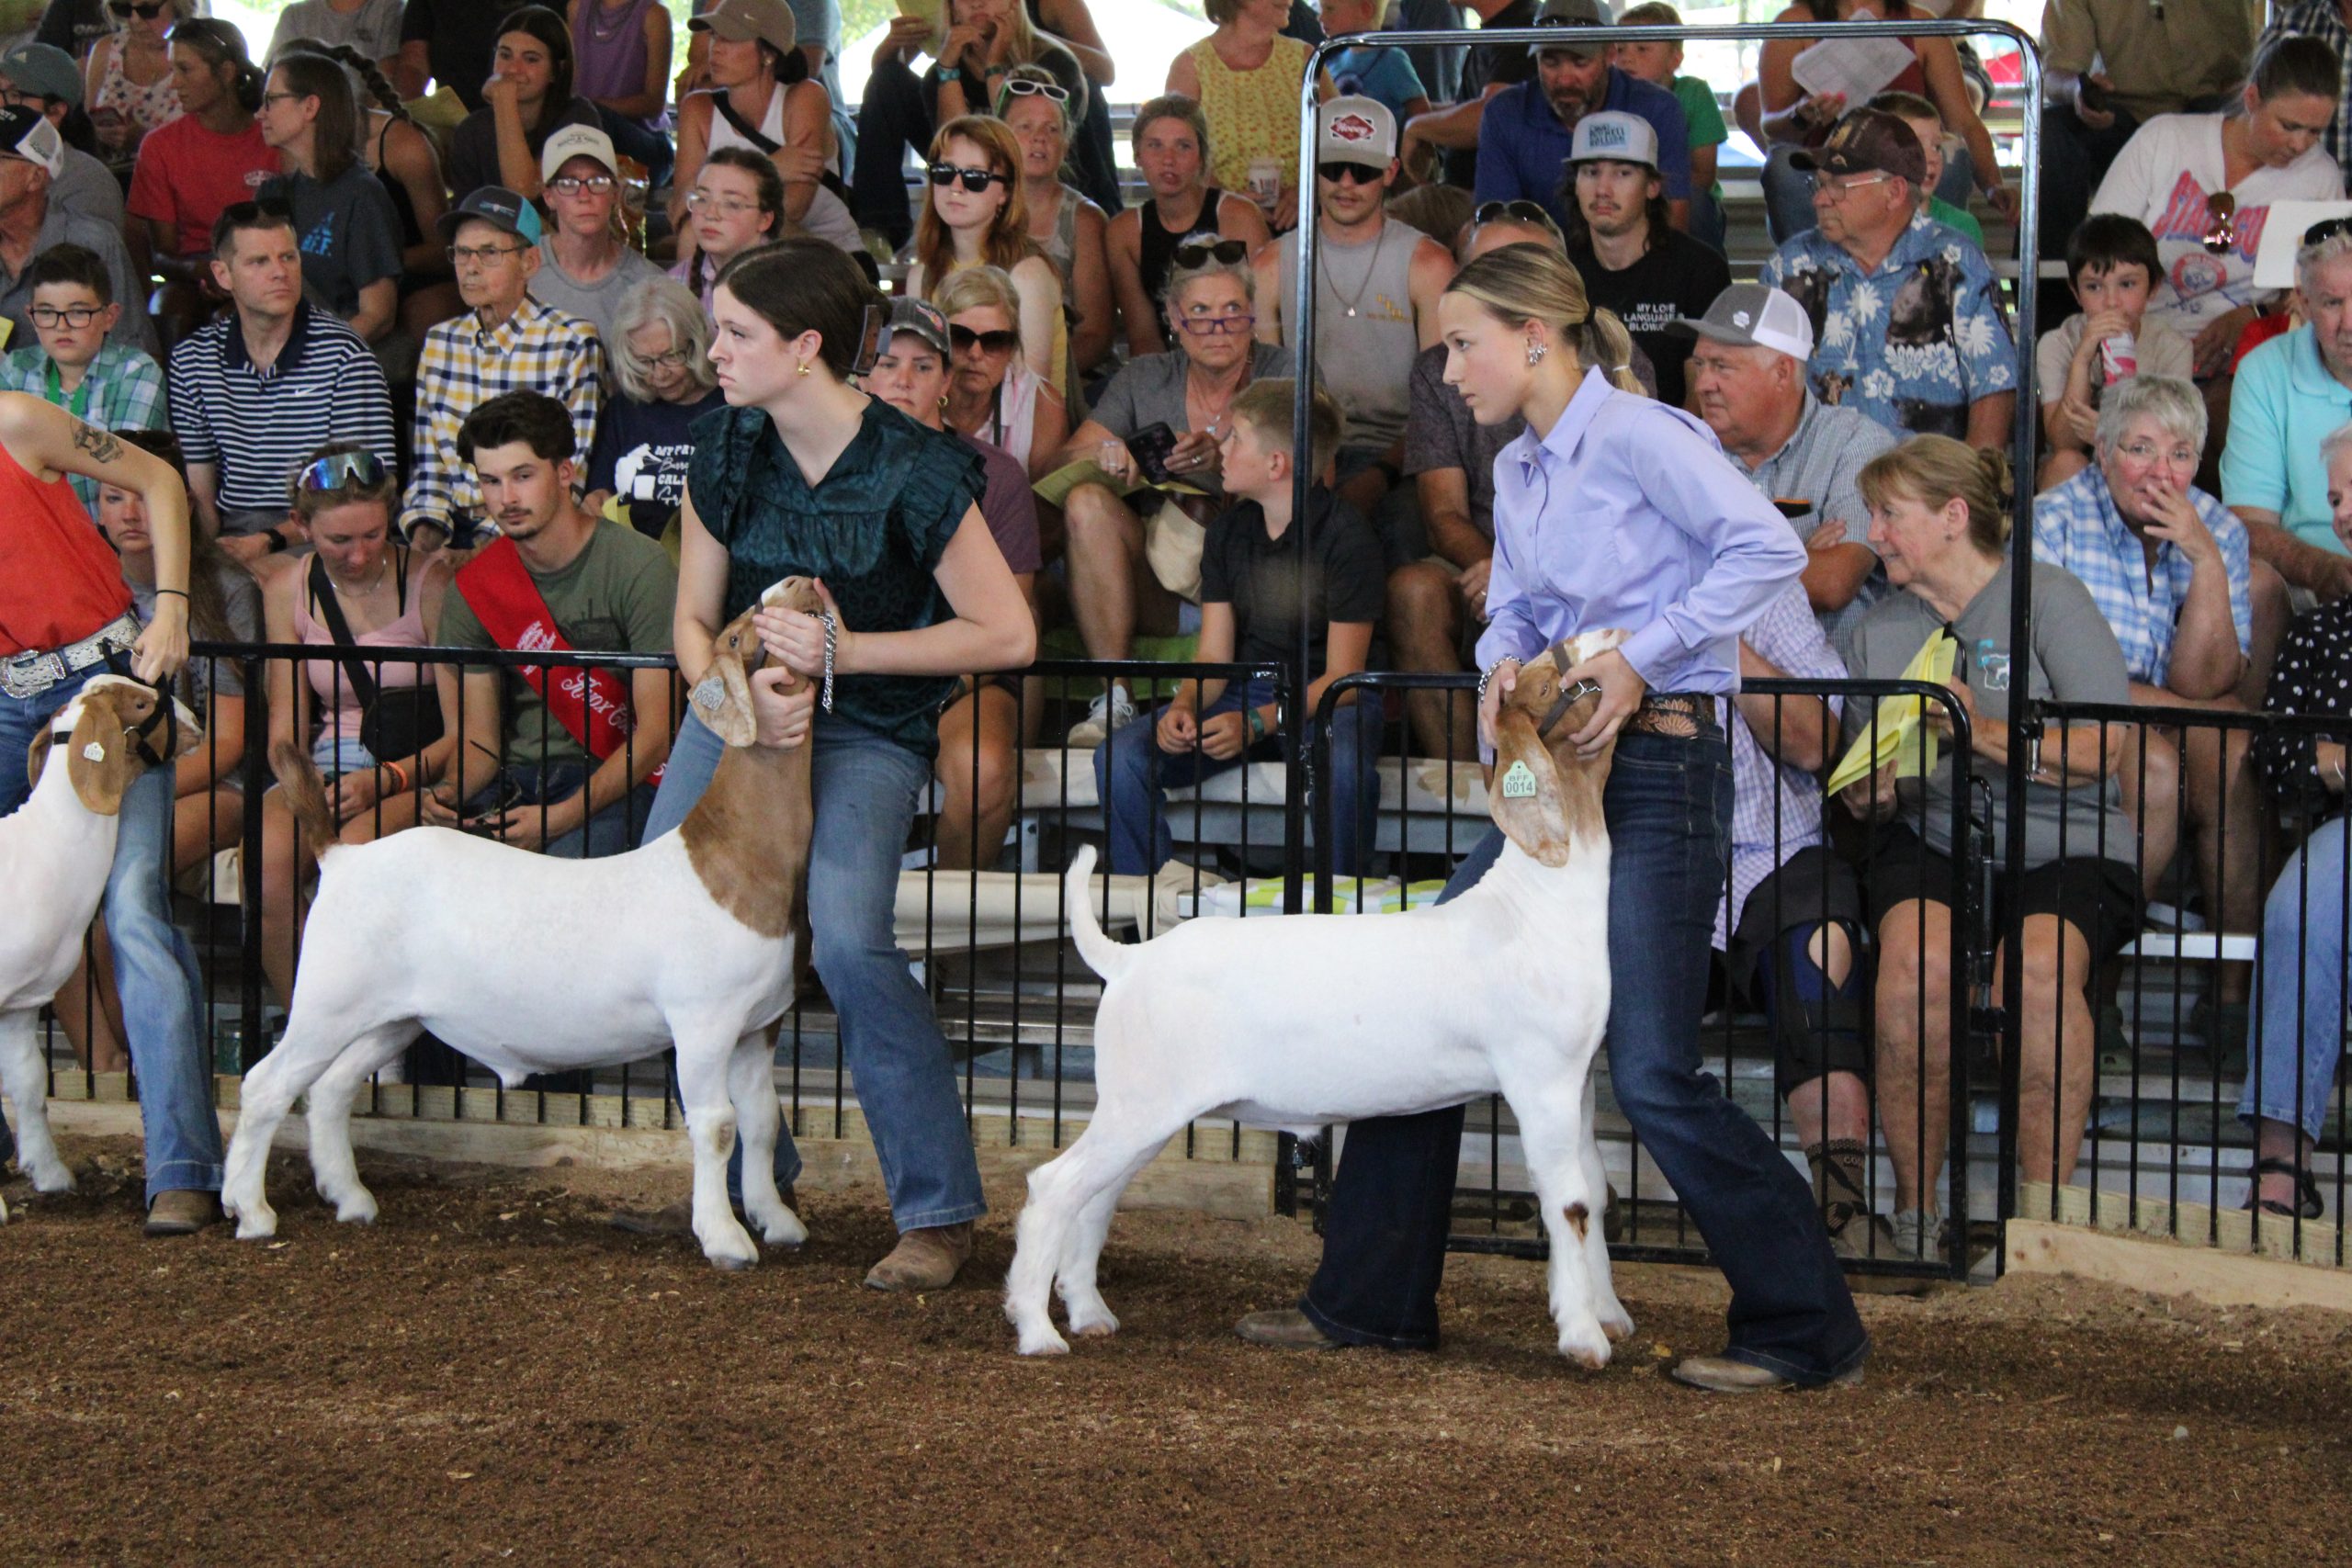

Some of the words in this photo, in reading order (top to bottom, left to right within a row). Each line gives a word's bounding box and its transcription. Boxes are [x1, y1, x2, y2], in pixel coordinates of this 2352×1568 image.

[1636, 303, 1651, 312] MY
[1629, 322, 1665, 332] BLOW
[655, 445, 674, 457] MY
[695, 690, 720, 708] 0090
[1506, 781, 1533, 794] 0014
